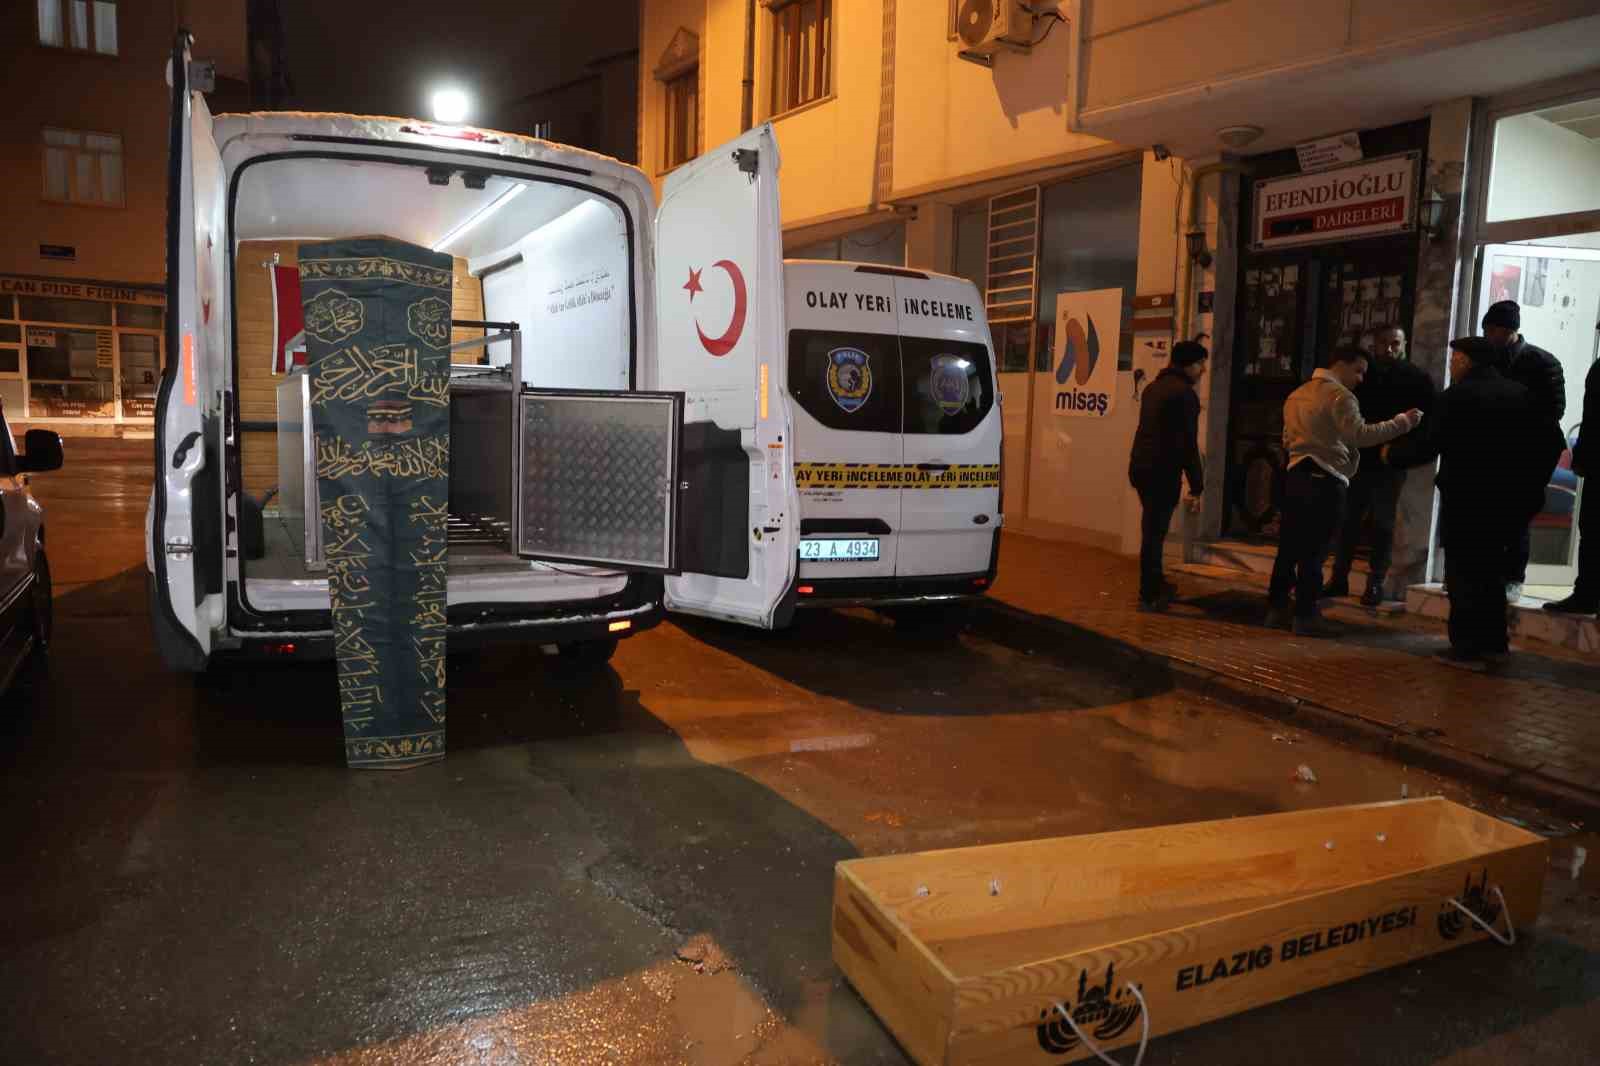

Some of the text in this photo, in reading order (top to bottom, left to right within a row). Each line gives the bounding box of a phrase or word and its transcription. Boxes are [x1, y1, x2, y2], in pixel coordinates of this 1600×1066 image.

[1265, 171, 1405, 212] EFENDİOĞLU
[1315, 205, 1396, 230] DAİRELERİ
[806, 291, 848, 309] OLAY
[1055, 387, 1108, 416] misaş
[804, 541, 876, 557] 23 A 4934
